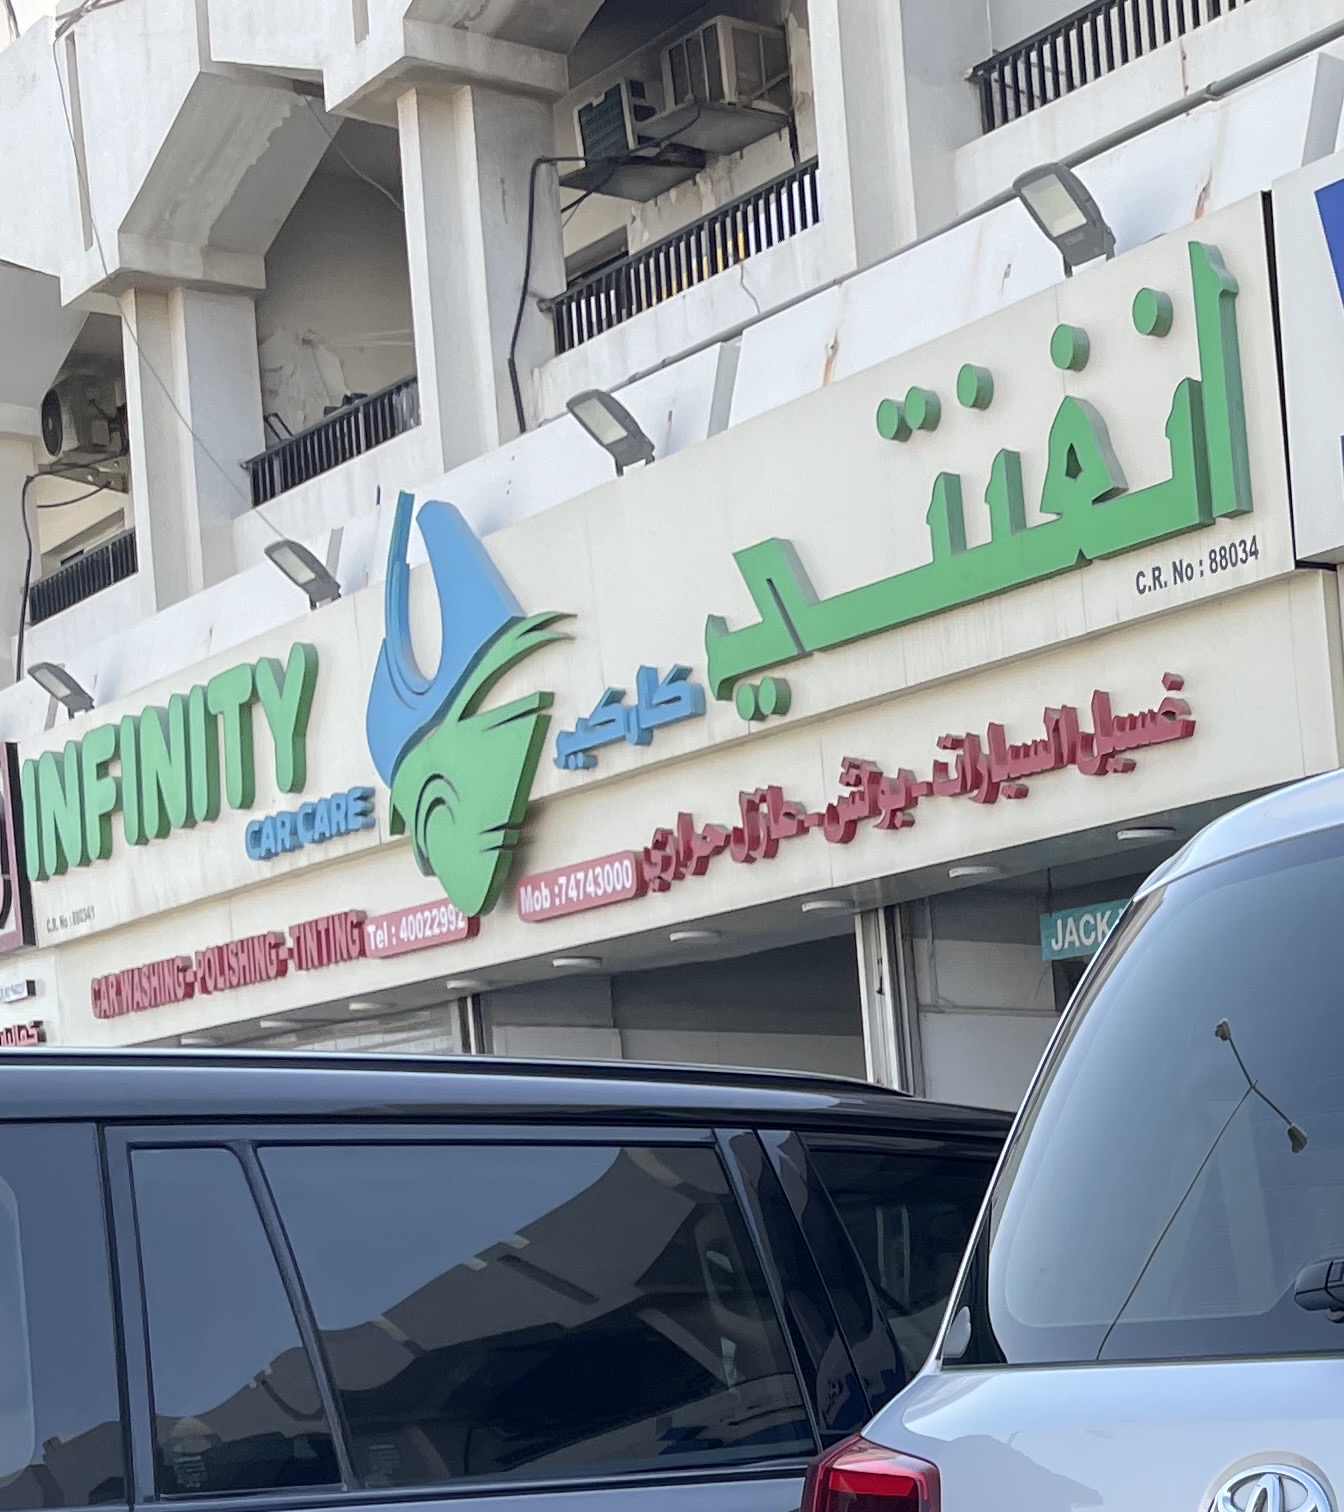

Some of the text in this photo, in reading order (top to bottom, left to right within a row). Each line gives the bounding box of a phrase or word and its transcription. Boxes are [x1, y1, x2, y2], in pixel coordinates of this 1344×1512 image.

[704, 241, 1254, 721] انفنتي
[1135, 566, 1168, 595] C.R.
[1172, 559, 1194, 585] No
[1208, 534, 1259, 574] 88034
[22, 641, 319, 883] INFINITY
[932, 703, 1079, 804] السيارات
[1077, 671, 1196, 776] غسيل
[245, 786, 376, 861] CAR CARE
[643, 812, 732, 892] حراري
[366, 923, 391, 952] Tel
[399, 905, 466, 942] 40022992
[519, 880, 551, 915] Mob
[1050, 908, 1112, 952] JACK
[90, 974, 120, 1019] CAR
[120, 956, 192, 1014] WASHING
[195, 931, 284, 996] POLISHING
[289, 909, 367, 973] TINTING
